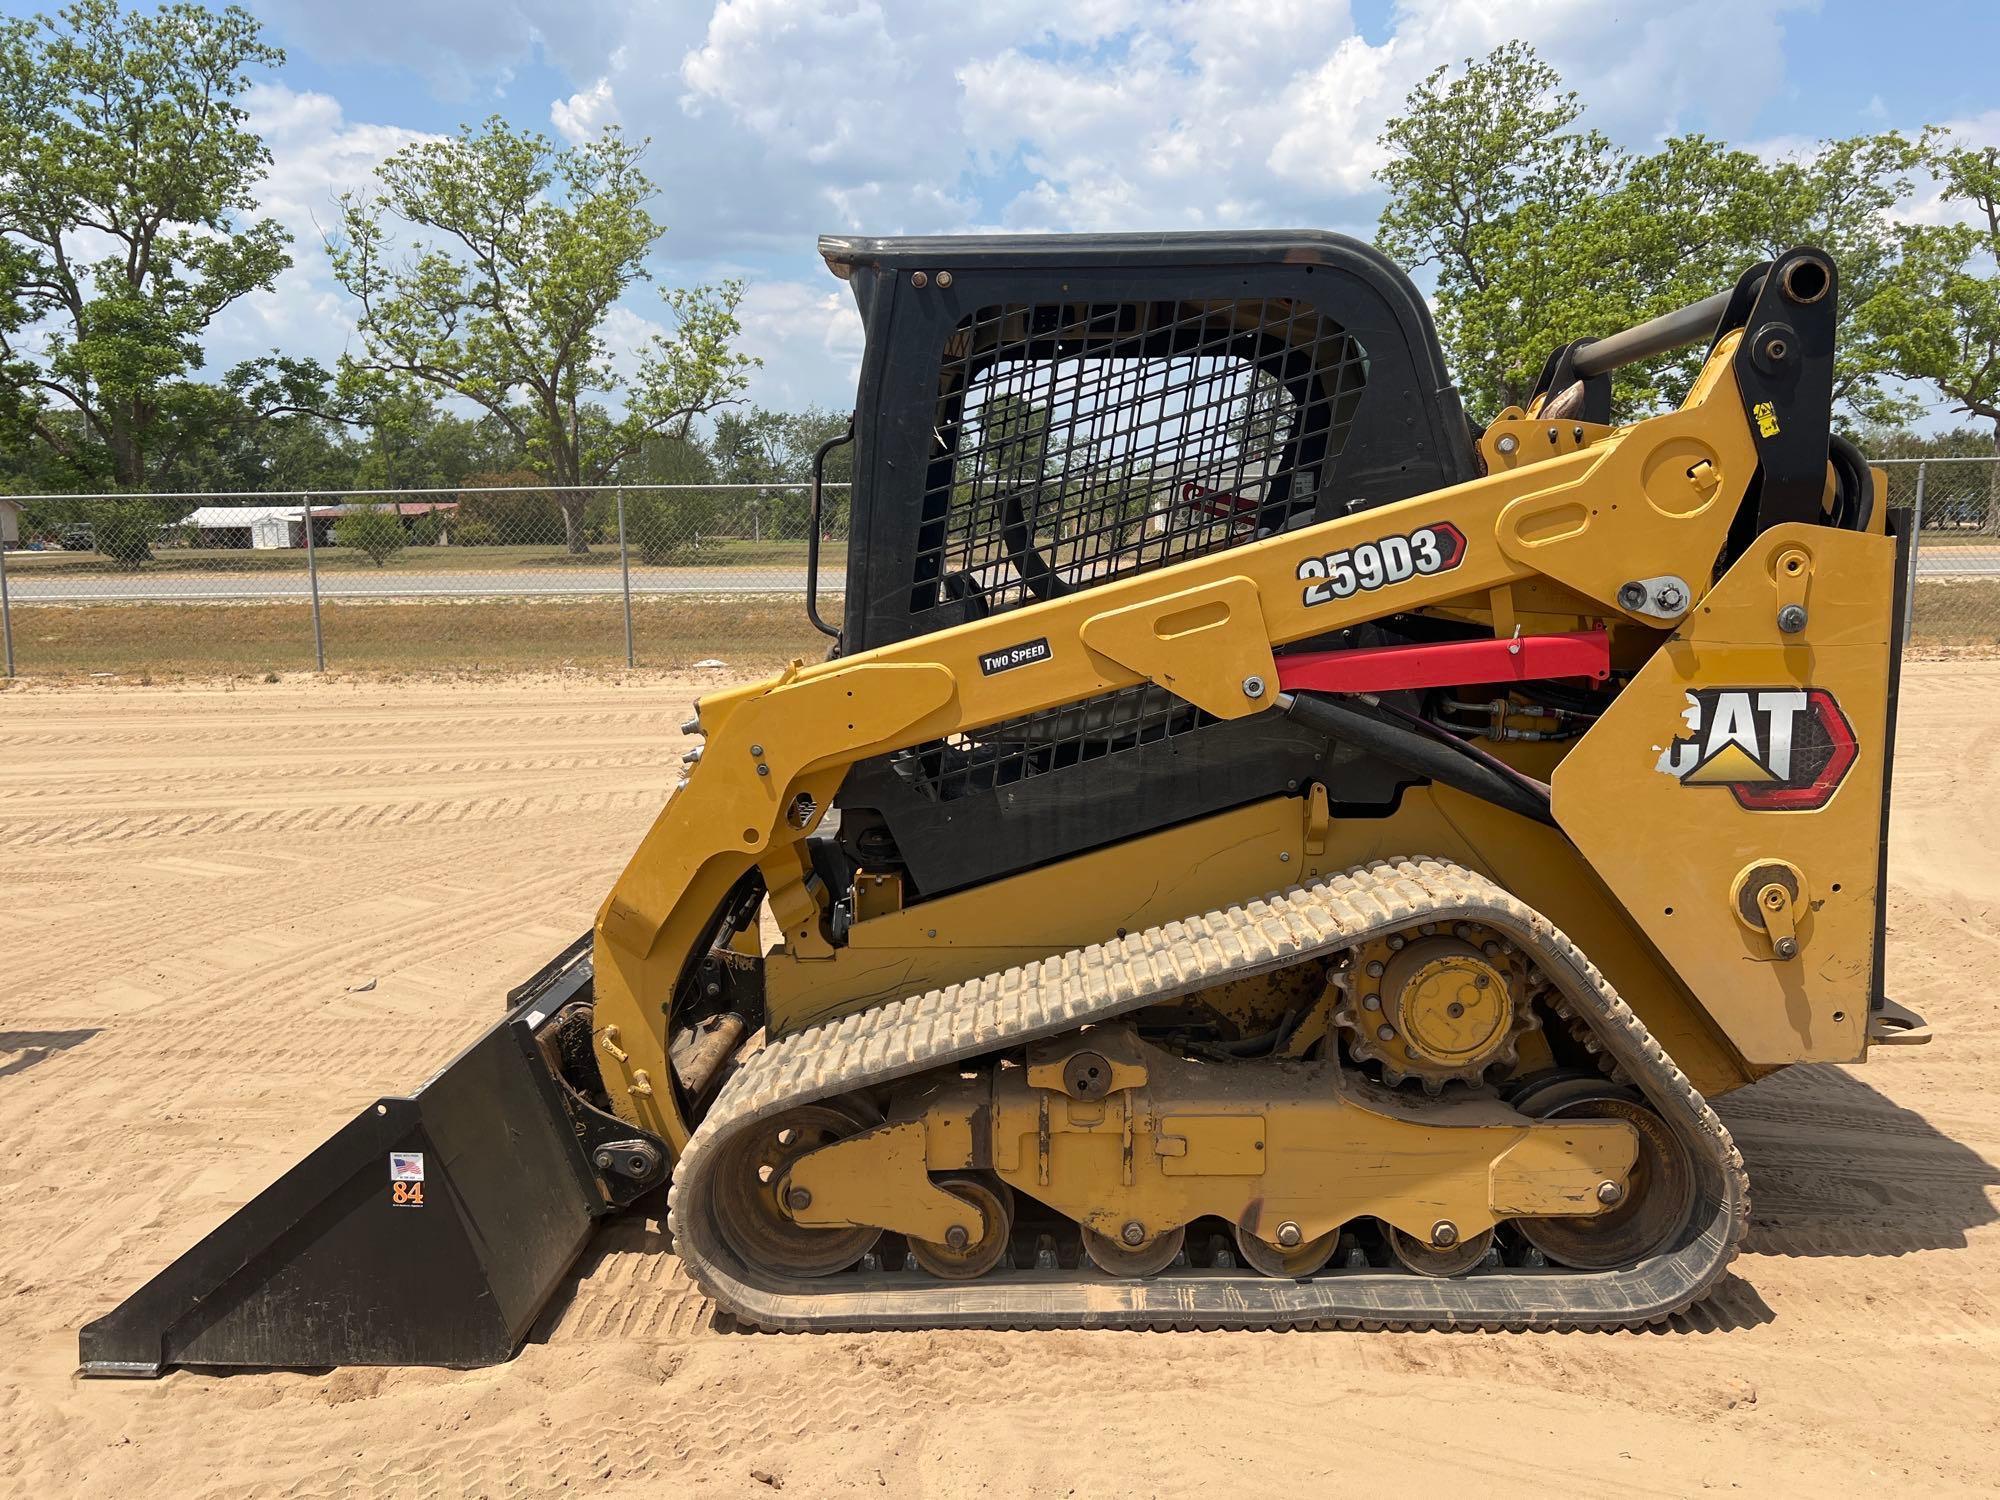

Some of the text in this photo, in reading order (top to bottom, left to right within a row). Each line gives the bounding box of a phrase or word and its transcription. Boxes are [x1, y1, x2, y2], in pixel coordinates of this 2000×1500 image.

[1299, 529, 1442, 604] 259D3
[984, 645, 1045, 671] TWO SPEED
[393, 1181, 424, 1204] 84
